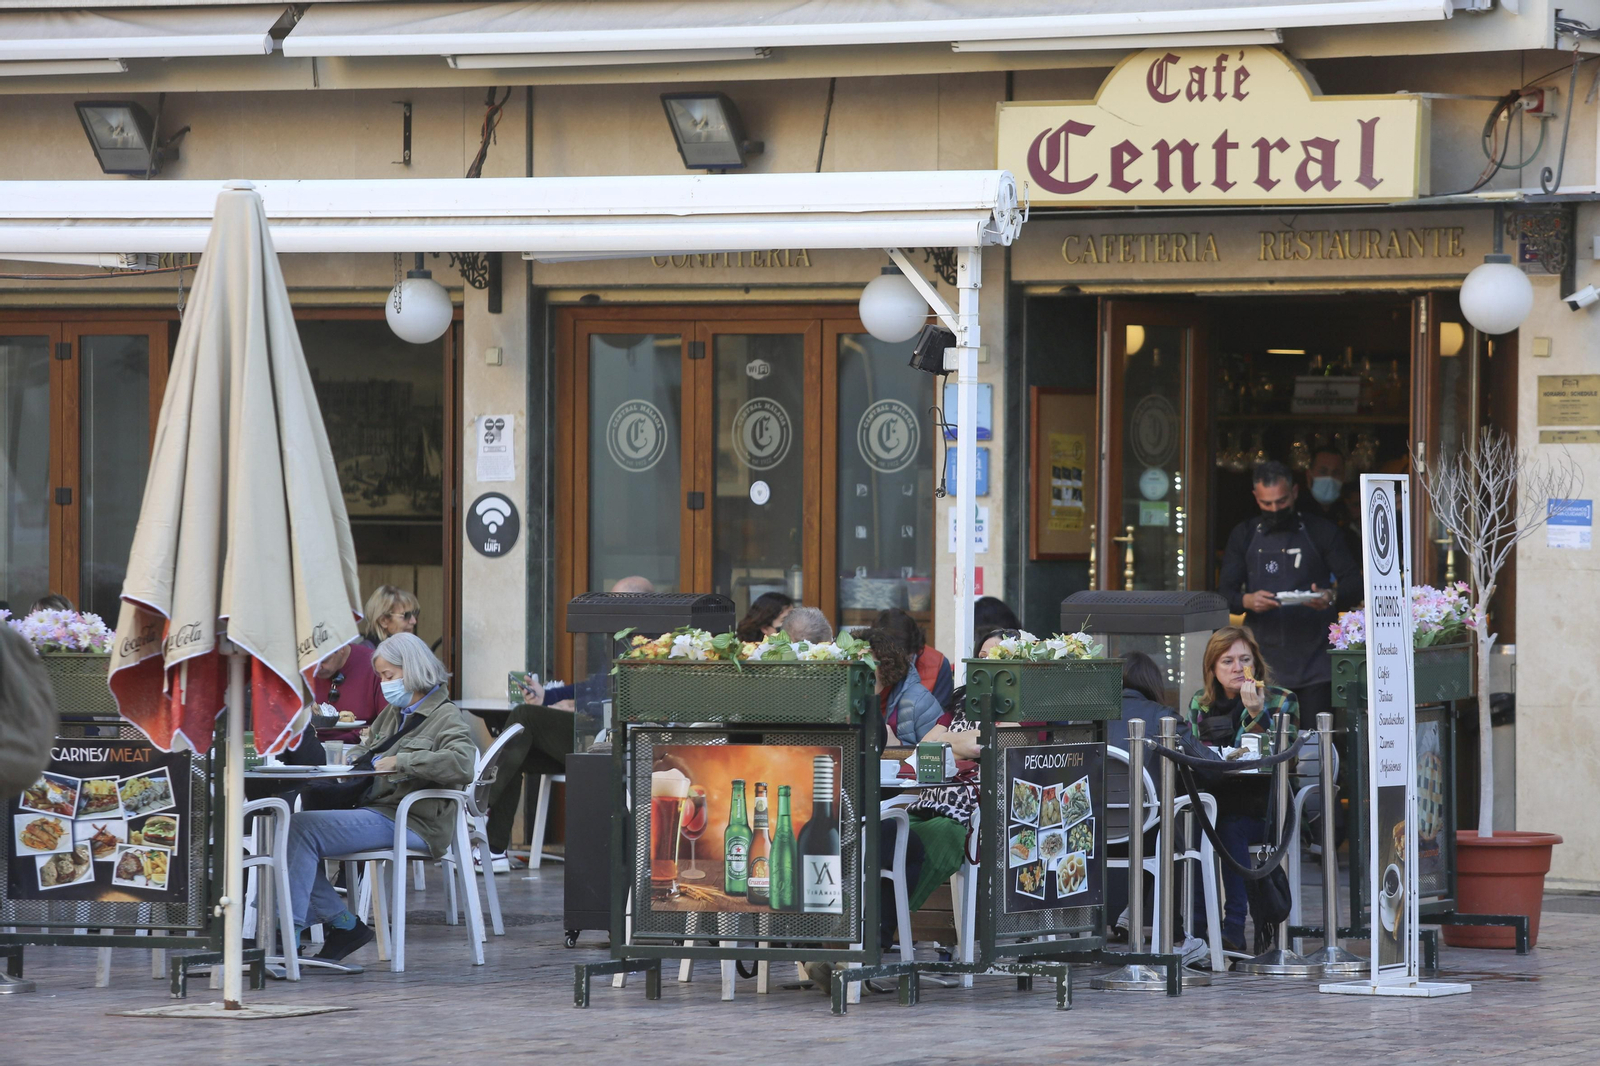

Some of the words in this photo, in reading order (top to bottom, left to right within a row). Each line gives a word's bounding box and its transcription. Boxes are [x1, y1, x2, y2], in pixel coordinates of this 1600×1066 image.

[1146, 50, 1250, 103] Café
[1027, 116, 1383, 194] Central
[1061, 231, 1220, 266] CAFETERIA
[1258, 226, 1464, 261] RESTAURANTE
[613, 404, 638, 428] CENTRAL
[737, 402, 762, 426] CENTRAL
[863, 404, 889, 428] CENTRAL
[1374, 595, 1400, 618] CHURROS
[1376, 643, 1398, 656] Chocolate
[1377, 666, 1390, 685] Cafés
